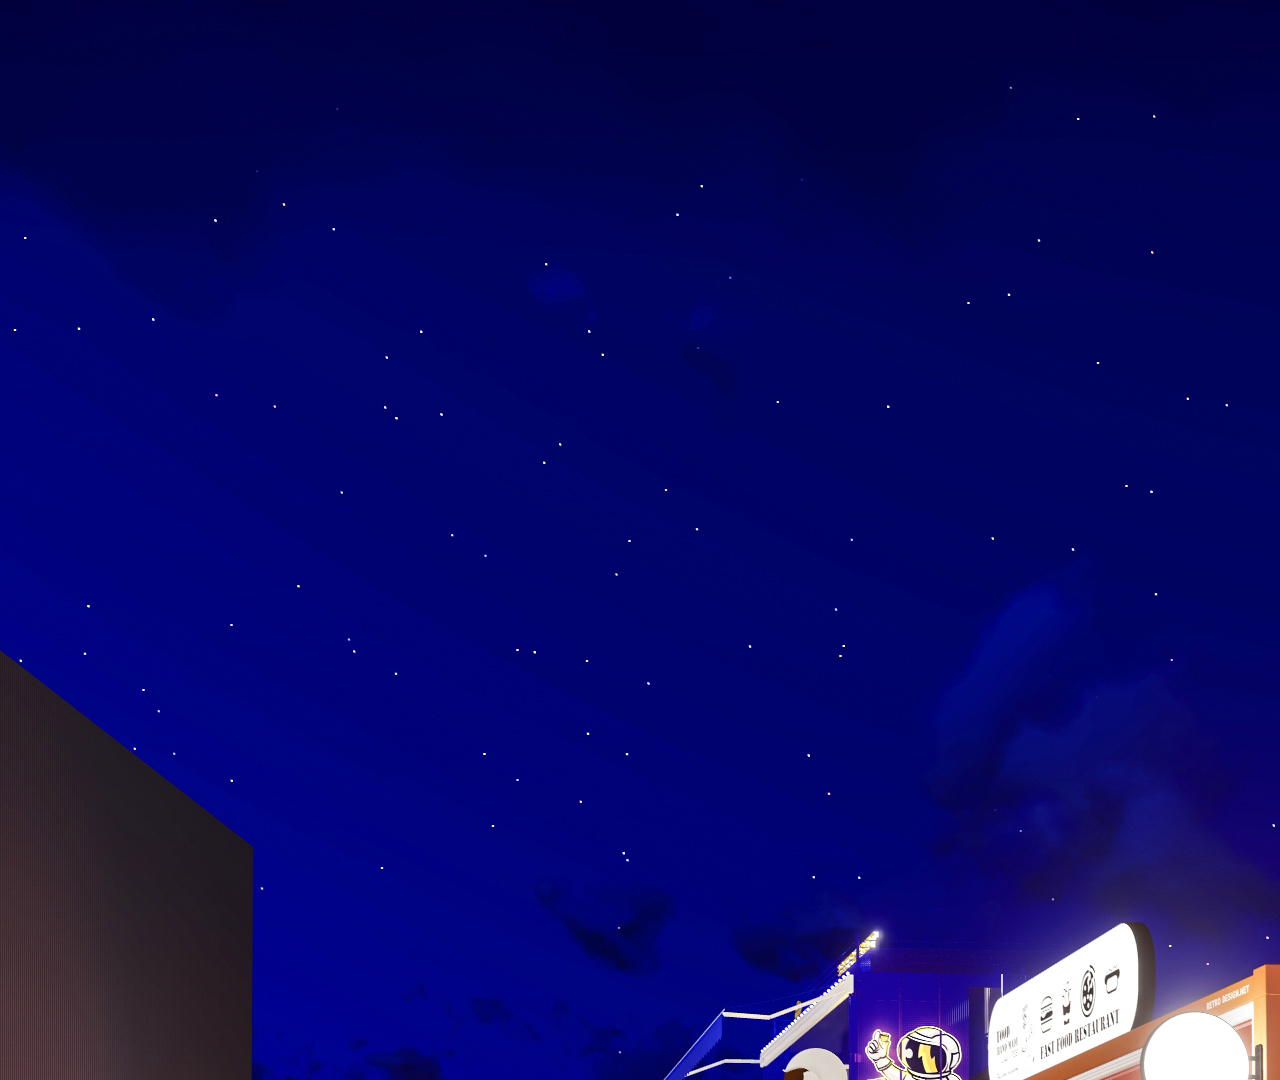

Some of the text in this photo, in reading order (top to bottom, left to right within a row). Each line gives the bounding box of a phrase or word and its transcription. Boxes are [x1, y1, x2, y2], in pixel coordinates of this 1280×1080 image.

[997, 1025, 1010, 1043] FOOD
[1040, 1008, 1120, 1060] FAST FOOD RESTAURANT
